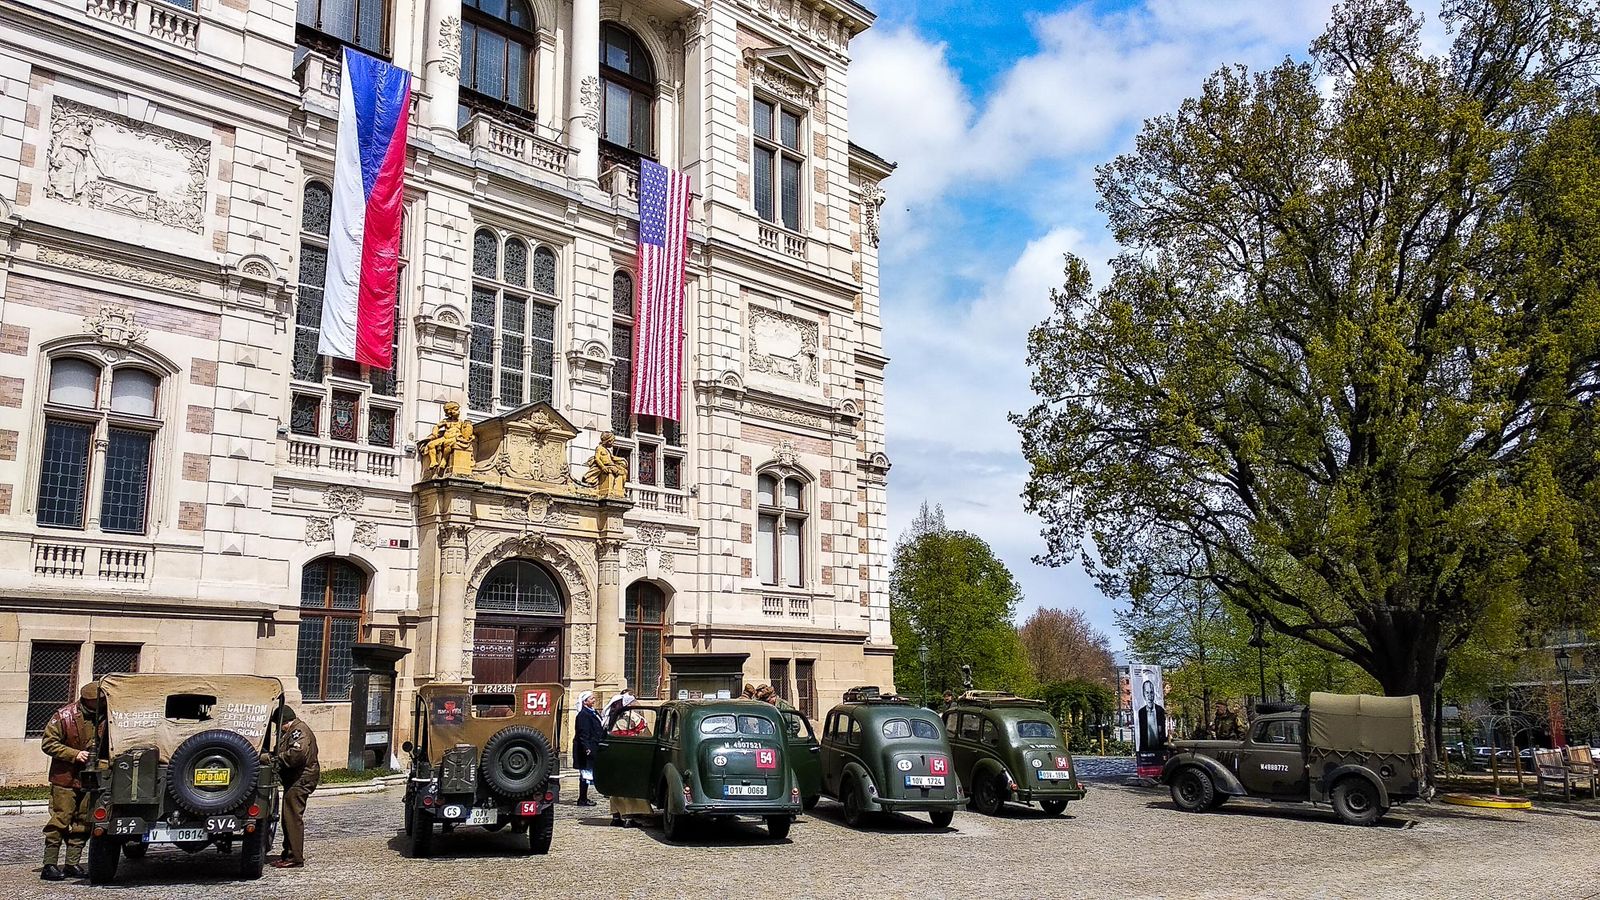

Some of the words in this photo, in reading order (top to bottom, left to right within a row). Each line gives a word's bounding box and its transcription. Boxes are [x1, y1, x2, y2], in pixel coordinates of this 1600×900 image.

[483, 685, 517, 694] 4242367
[526, 692, 547, 710] 54
[227, 703, 268, 714] CAUTION
[112, 710, 130, 720] MAX
[131, 712, 159, 720] SPEED
[223, 713, 244, 721] LEFT
[245, 714, 268, 722] HAND
[118, 720, 129, 728] 40
[233, 720, 257, 729] DRIVE
[236, 728, 265, 737] SIGNAL
[760, 752, 773, 764] 54
[1057, 757, 1067, 767] 54
[933, 760, 945, 771] 54
[927, 777, 942, 785] 1724
[729, 786, 743, 795] 01V
[447, 807, 458, 816] CS
[523, 803, 535, 813] 54
[178, 829, 205, 841] 0814
